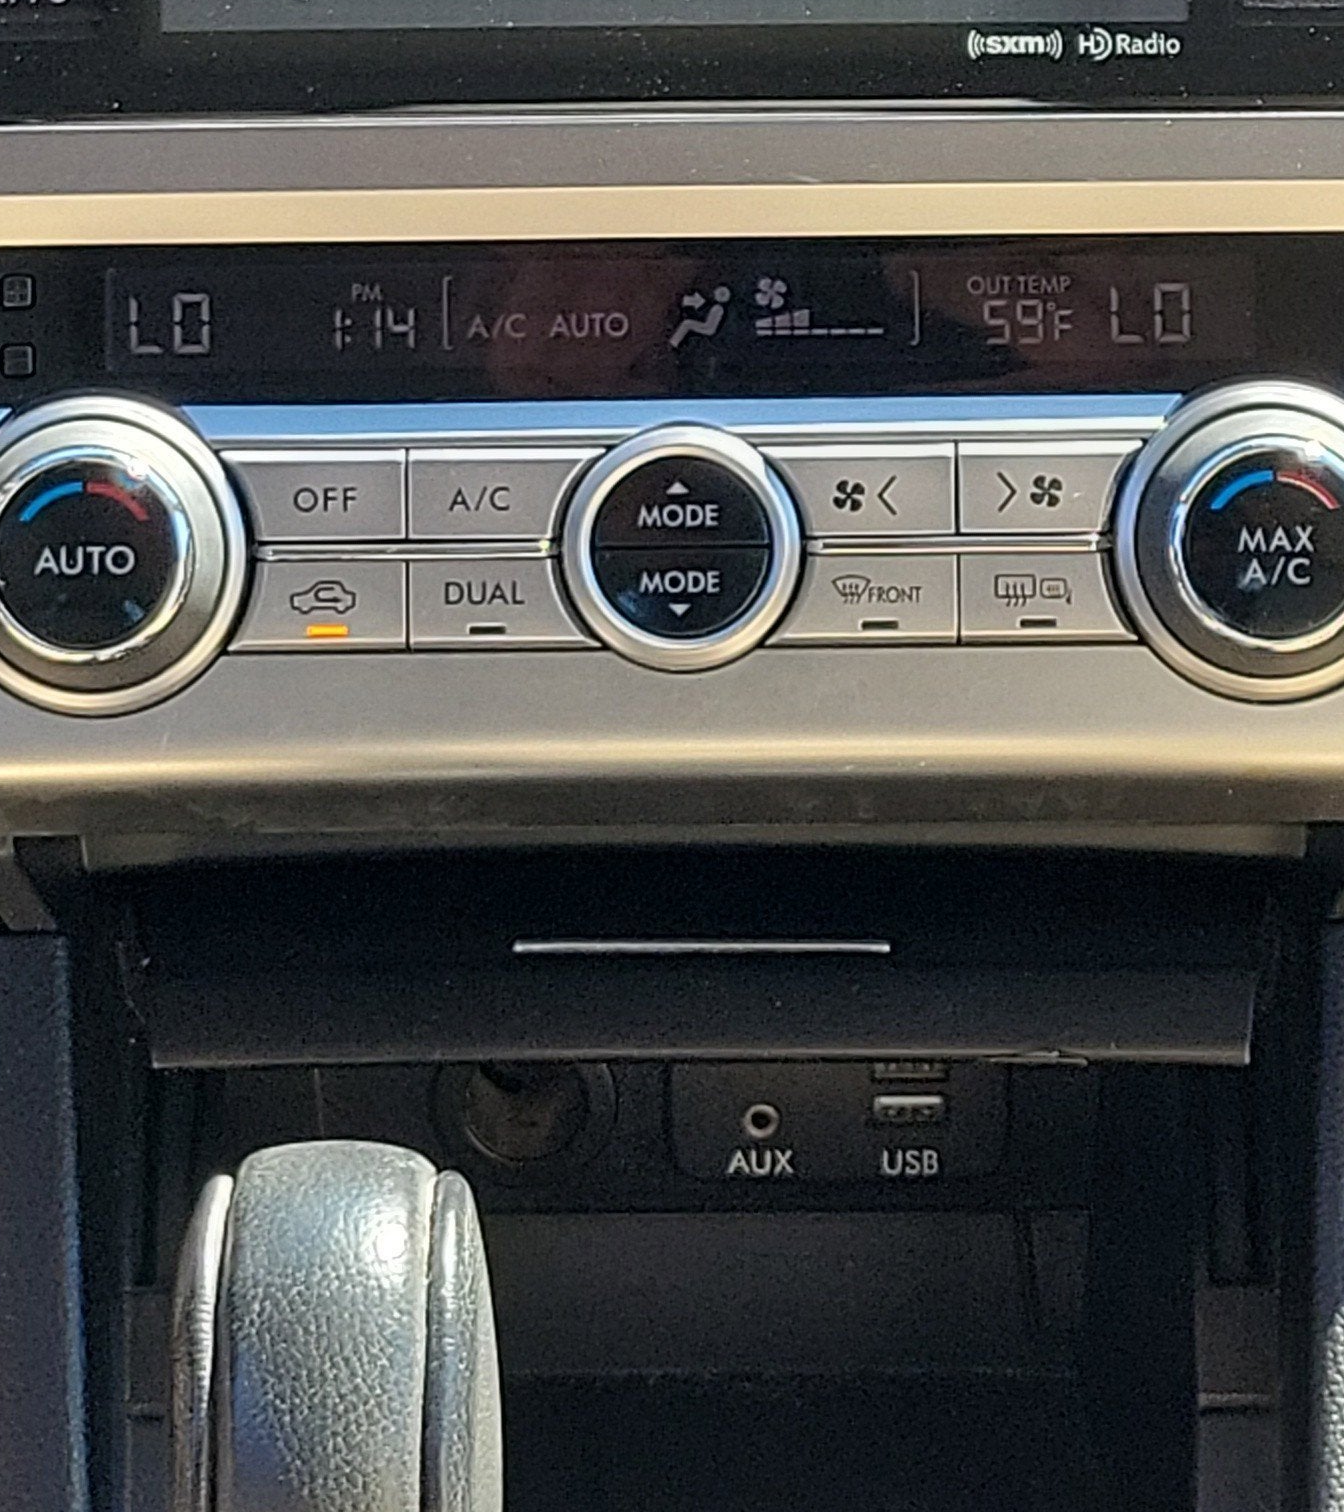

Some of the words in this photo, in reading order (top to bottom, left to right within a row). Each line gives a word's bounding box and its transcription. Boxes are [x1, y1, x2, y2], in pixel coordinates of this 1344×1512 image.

[1115, 31, 1181, 56] Radio
[351, 283, 383, 301] PM
[967, 276, 1010, 294] OUT
[1016, 276, 1071, 294] TEMP
[335, 308, 416, 349] 1:14
[467, 313, 527, 338] A/C
[549, 312, 629, 338] AUTO
[293, 487, 358, 513] OFF
[448, 486, 510, 512] A/C
[637, 504, 719, 527] MODE
[1237, 526, 1314, 553] MAX
[34, 544, 136, 576] AUTO
[1241, 556, 1311, 586] A/C
[444, 581, 525, 605] DUAL
[640, 571, 720, 593] MODE
[868, 586, 922, 604] FRONT
[727, 1149, 794, 1175] AUX
[882, 1149, 939, 1175] USB
